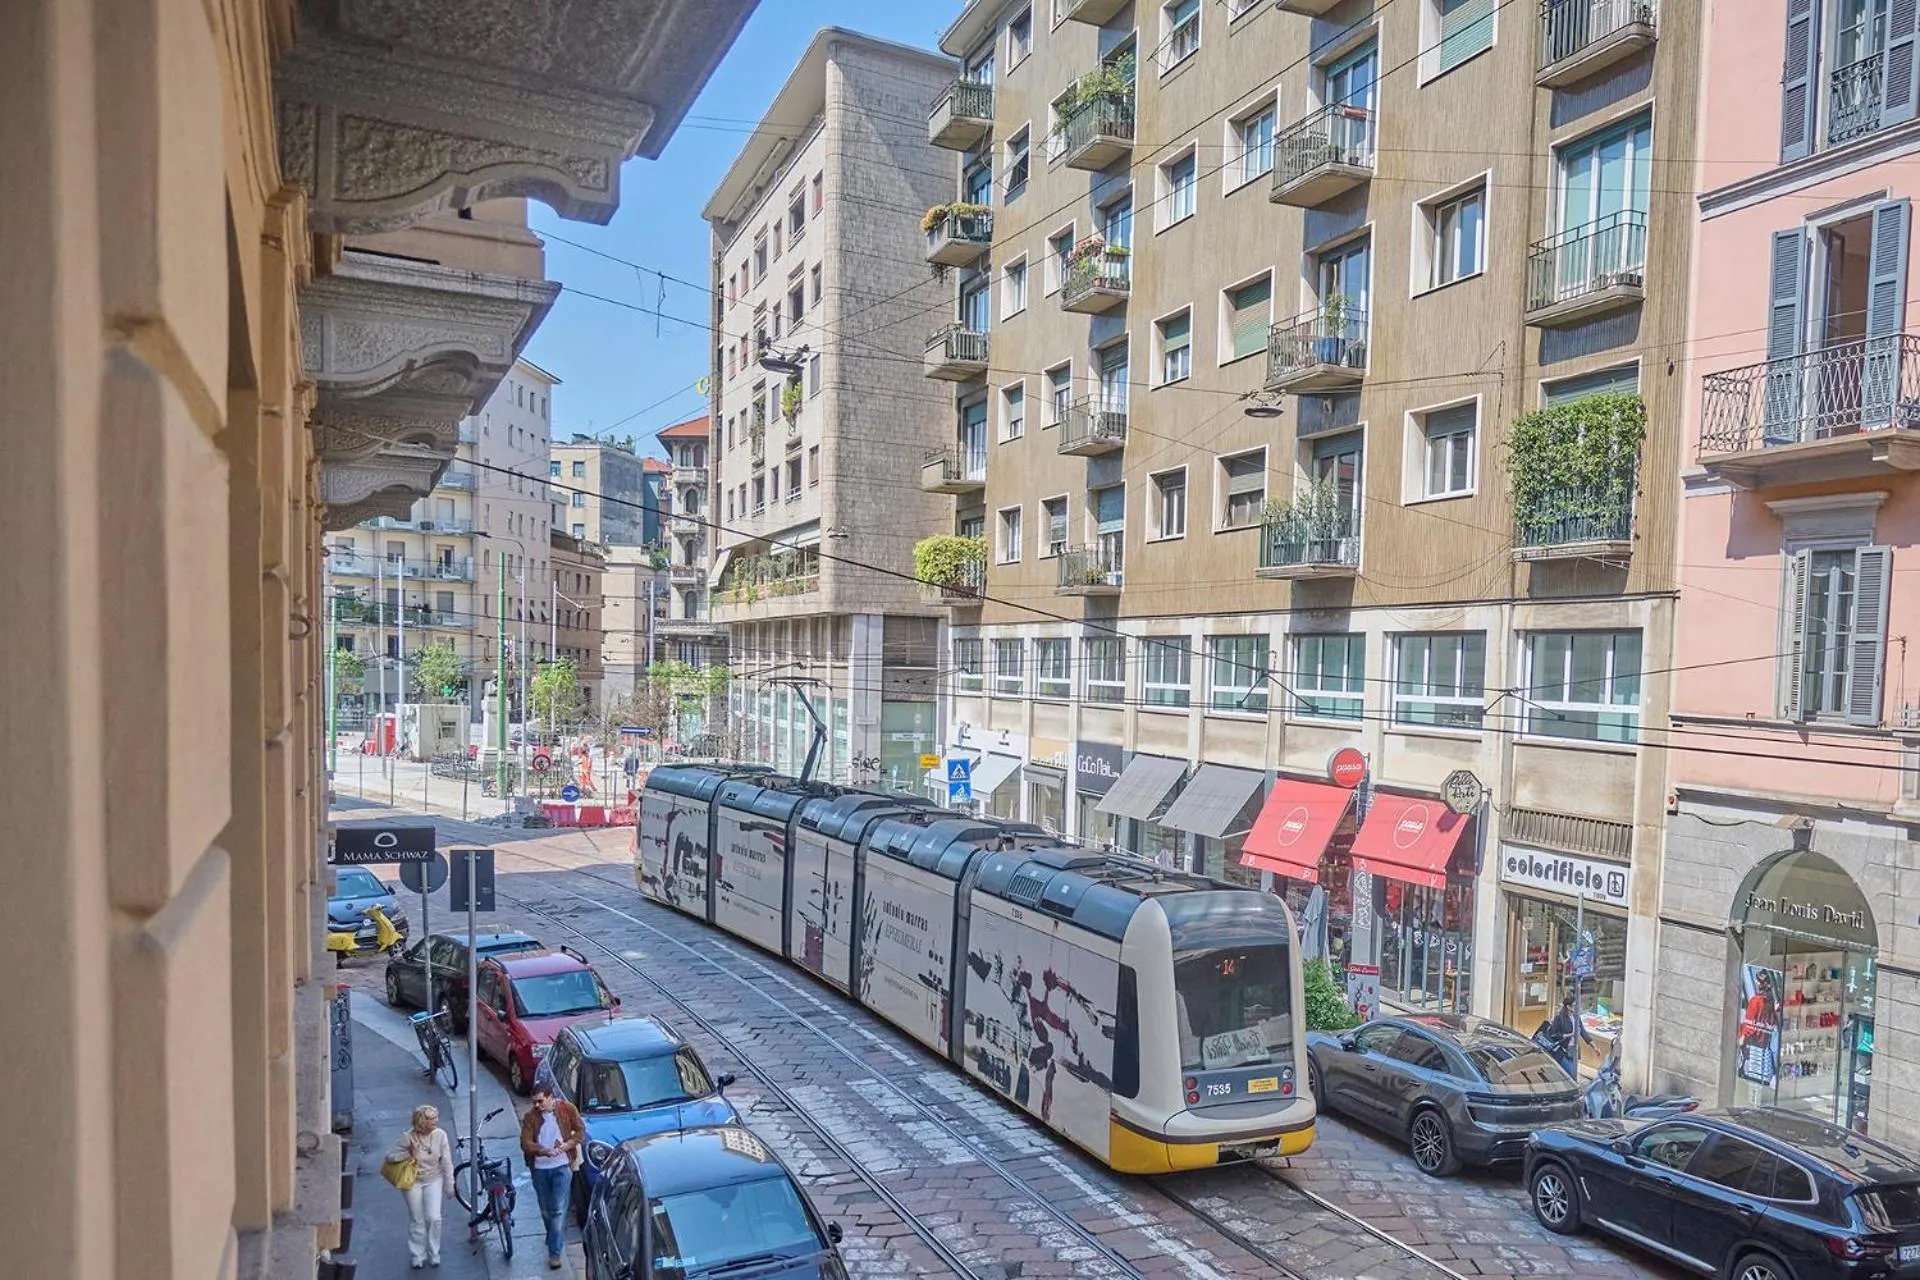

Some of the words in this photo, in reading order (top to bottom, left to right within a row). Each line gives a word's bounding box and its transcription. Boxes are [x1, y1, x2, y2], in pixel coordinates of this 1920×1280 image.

[343, 852, 381, 861] MAMA
[384, 850, 428, 860] SCHWAZ
[1507, 855, 1603, 890] colorificio
[1745, 891, 1777, 913] Jean
[1781, 896, 1818, 920] Louis
[1824, 904, 1865, 930] David
[1207, 1083, 1231, 1096] 7535
